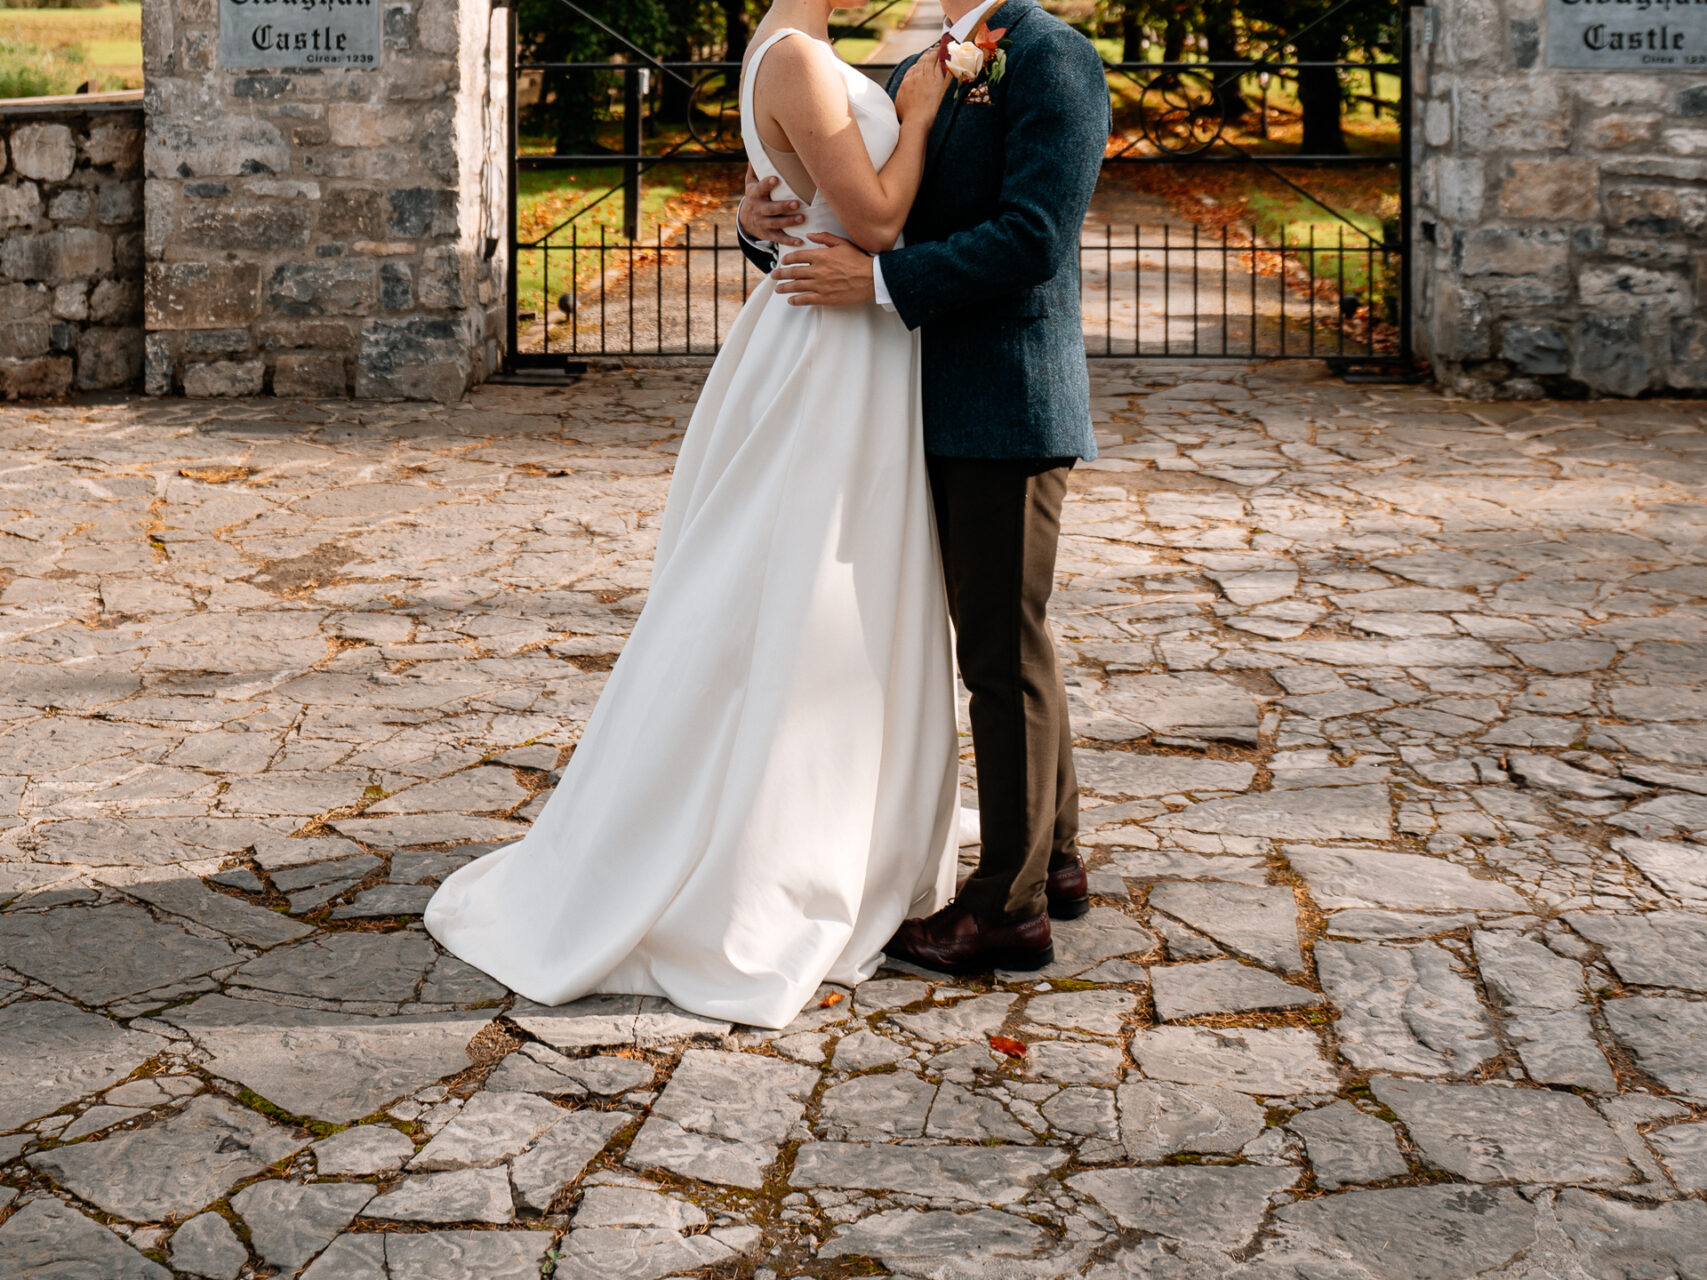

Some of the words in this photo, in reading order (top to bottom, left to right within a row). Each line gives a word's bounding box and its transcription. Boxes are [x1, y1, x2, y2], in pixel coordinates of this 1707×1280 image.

[252, 24, 347, 51] Castle
[1583, 24, 1685, 51] Castle
[346, 54, 374, 63] 1239
